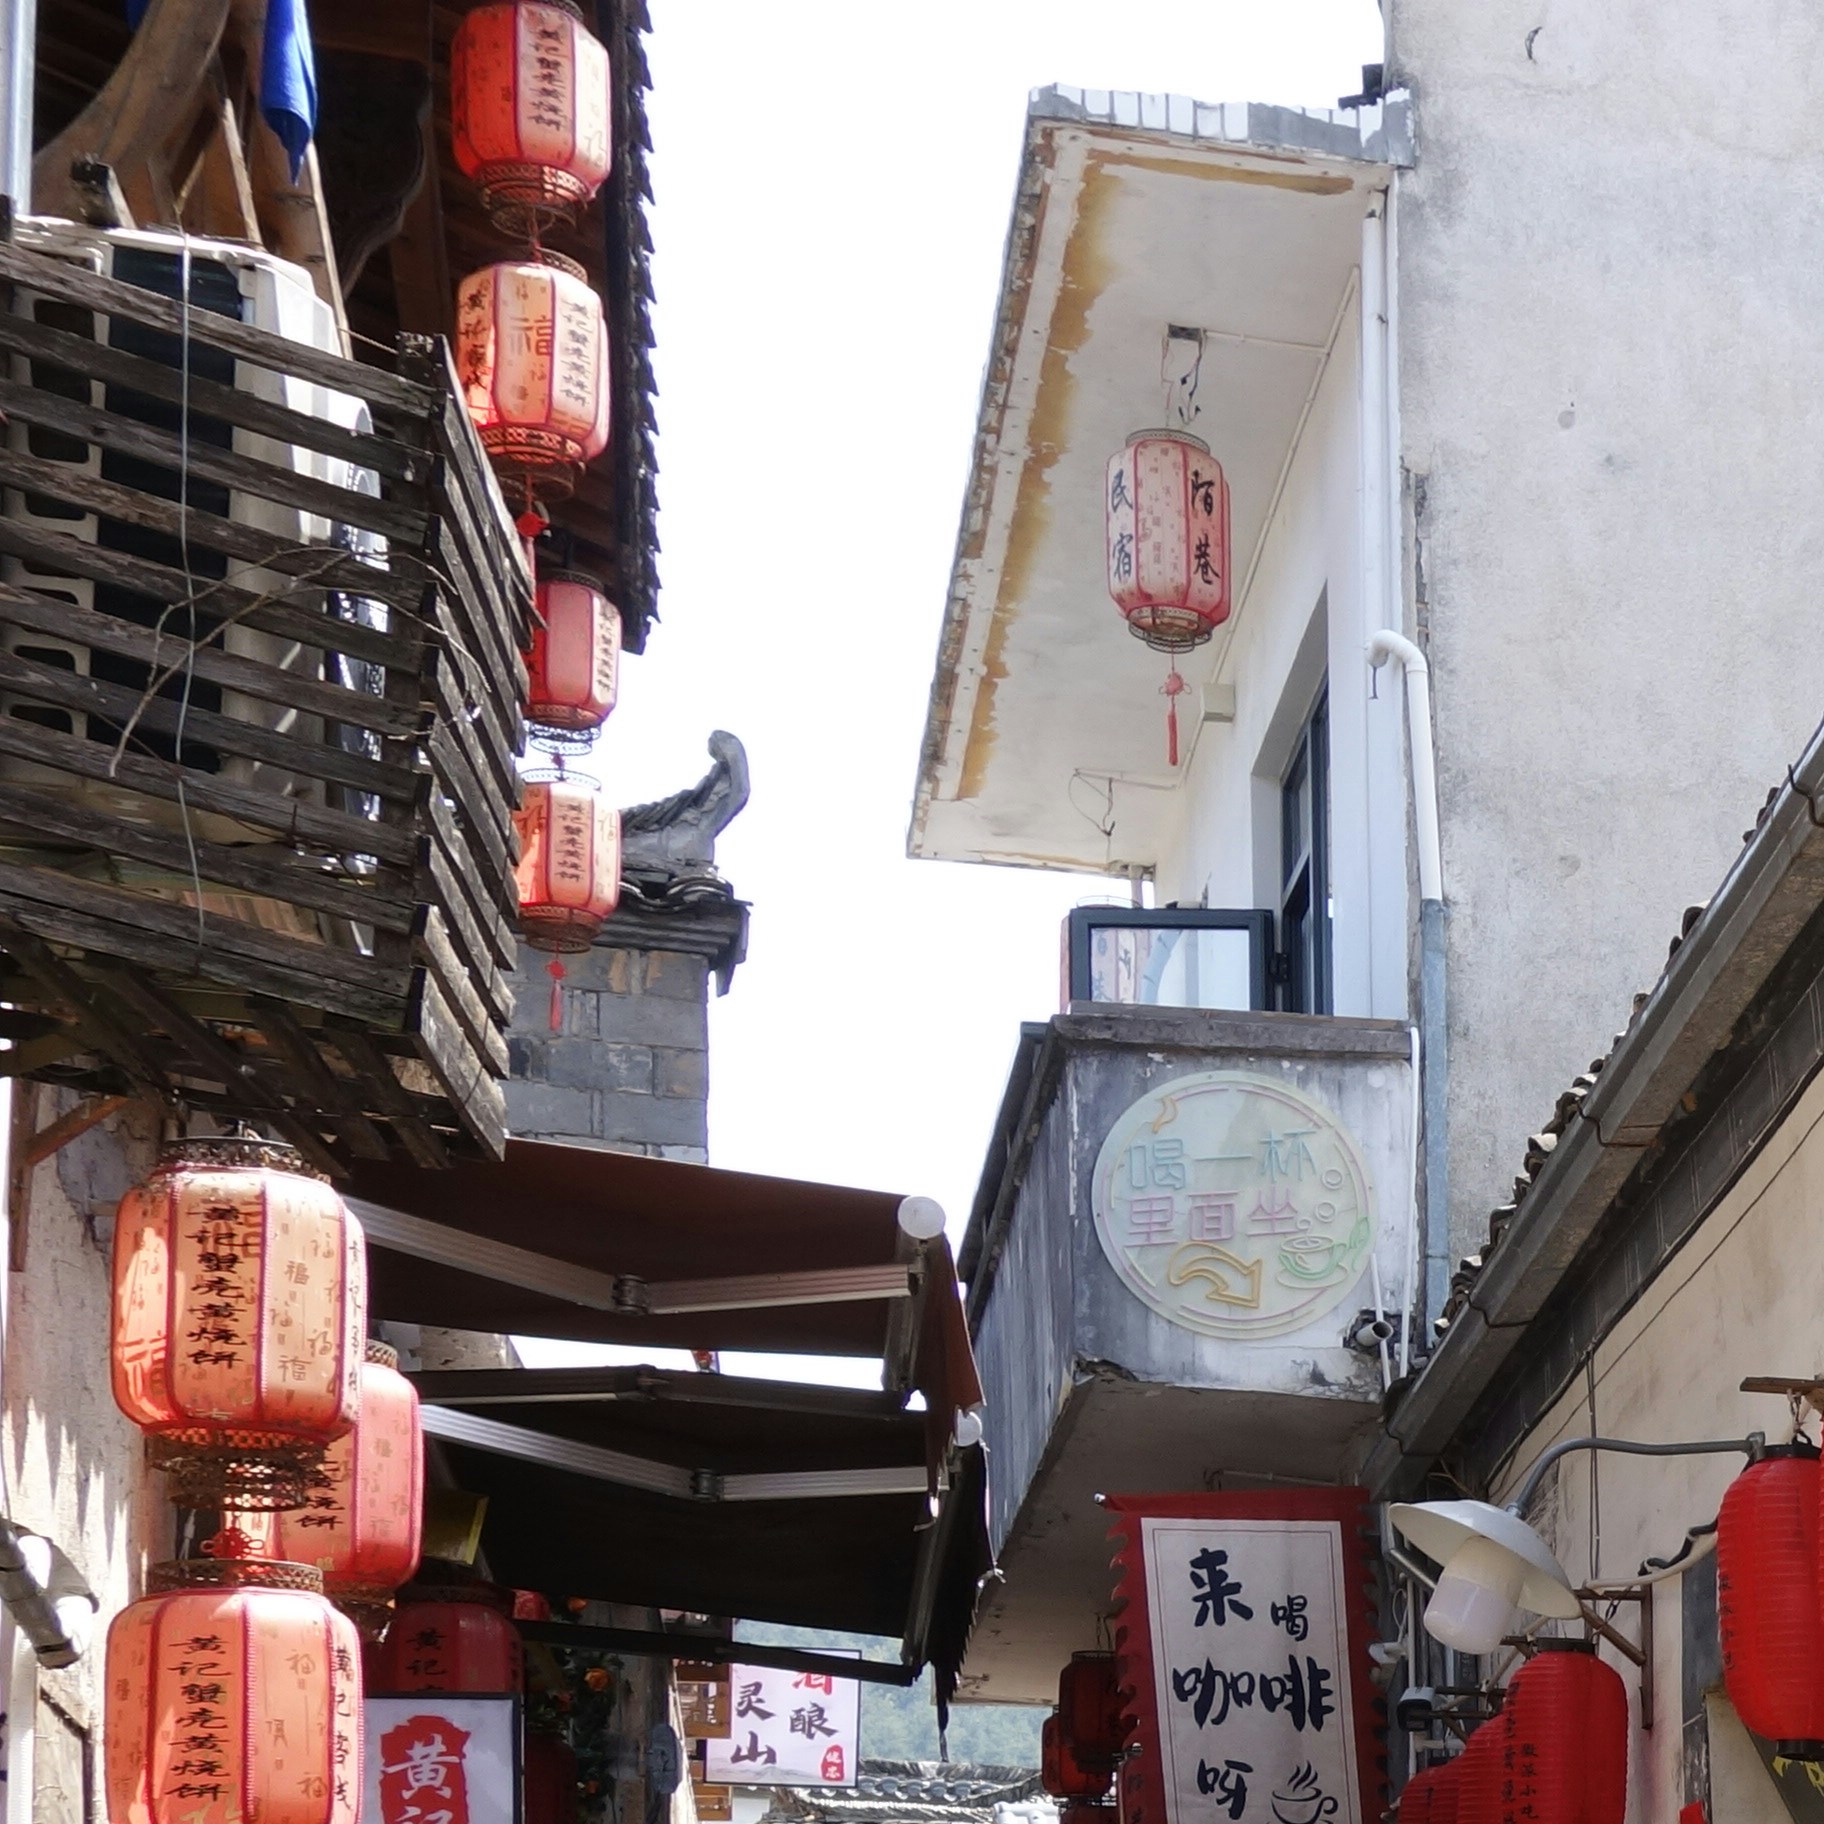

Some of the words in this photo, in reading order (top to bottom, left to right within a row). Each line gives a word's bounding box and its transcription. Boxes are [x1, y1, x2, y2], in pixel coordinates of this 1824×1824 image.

[1110, 468, 1134, 582] 民宿
[1125, 1128, 1319, 1191] 喝一杯
[1123, 1185, 1300, 1248] 里面坐
[404, 1626, 448, 1690] 黄记
[729, 1681, 778, 1766] 灵山
[1172, 1653, 1335, 1733] 咖啡
[1196, 1758, 1254, 1821] 呀
